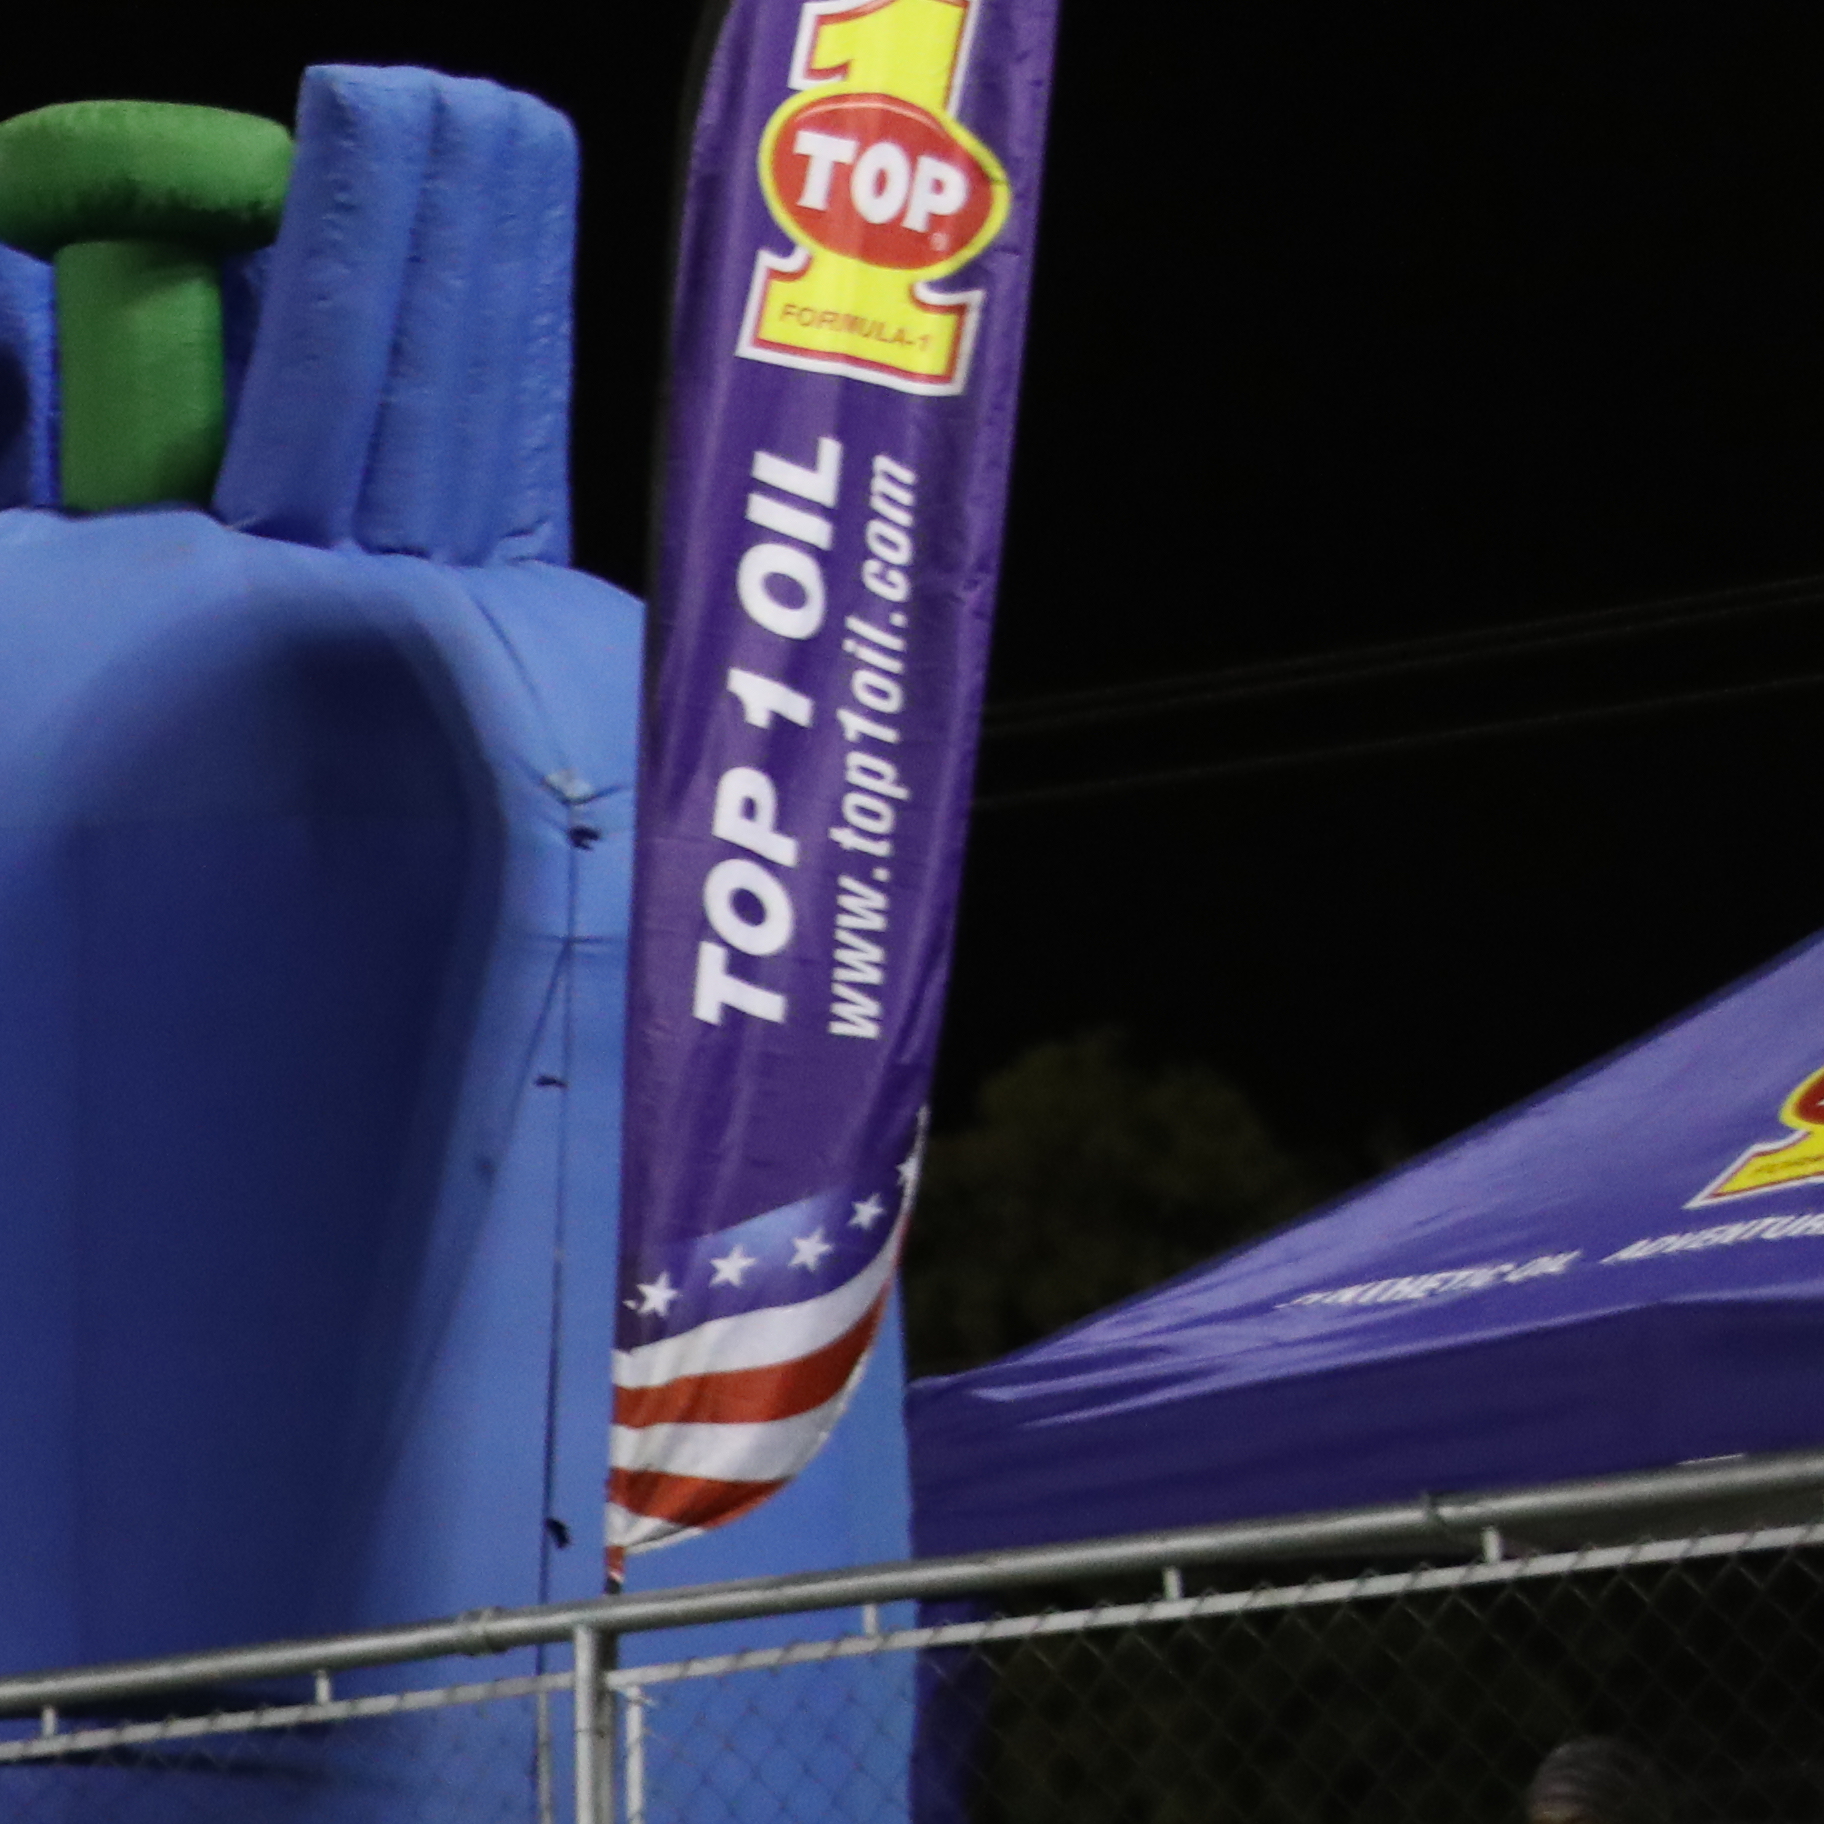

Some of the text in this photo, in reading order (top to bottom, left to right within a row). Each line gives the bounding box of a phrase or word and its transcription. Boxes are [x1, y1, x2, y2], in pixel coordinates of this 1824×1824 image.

[779, 303, 932, 352] FORMULA-1
[793, 129, 970, 234] TOP
[692, 436, 843, 1026] TOP 1 OIL
[827, 453, 919, 1040] www.top1oil.com
